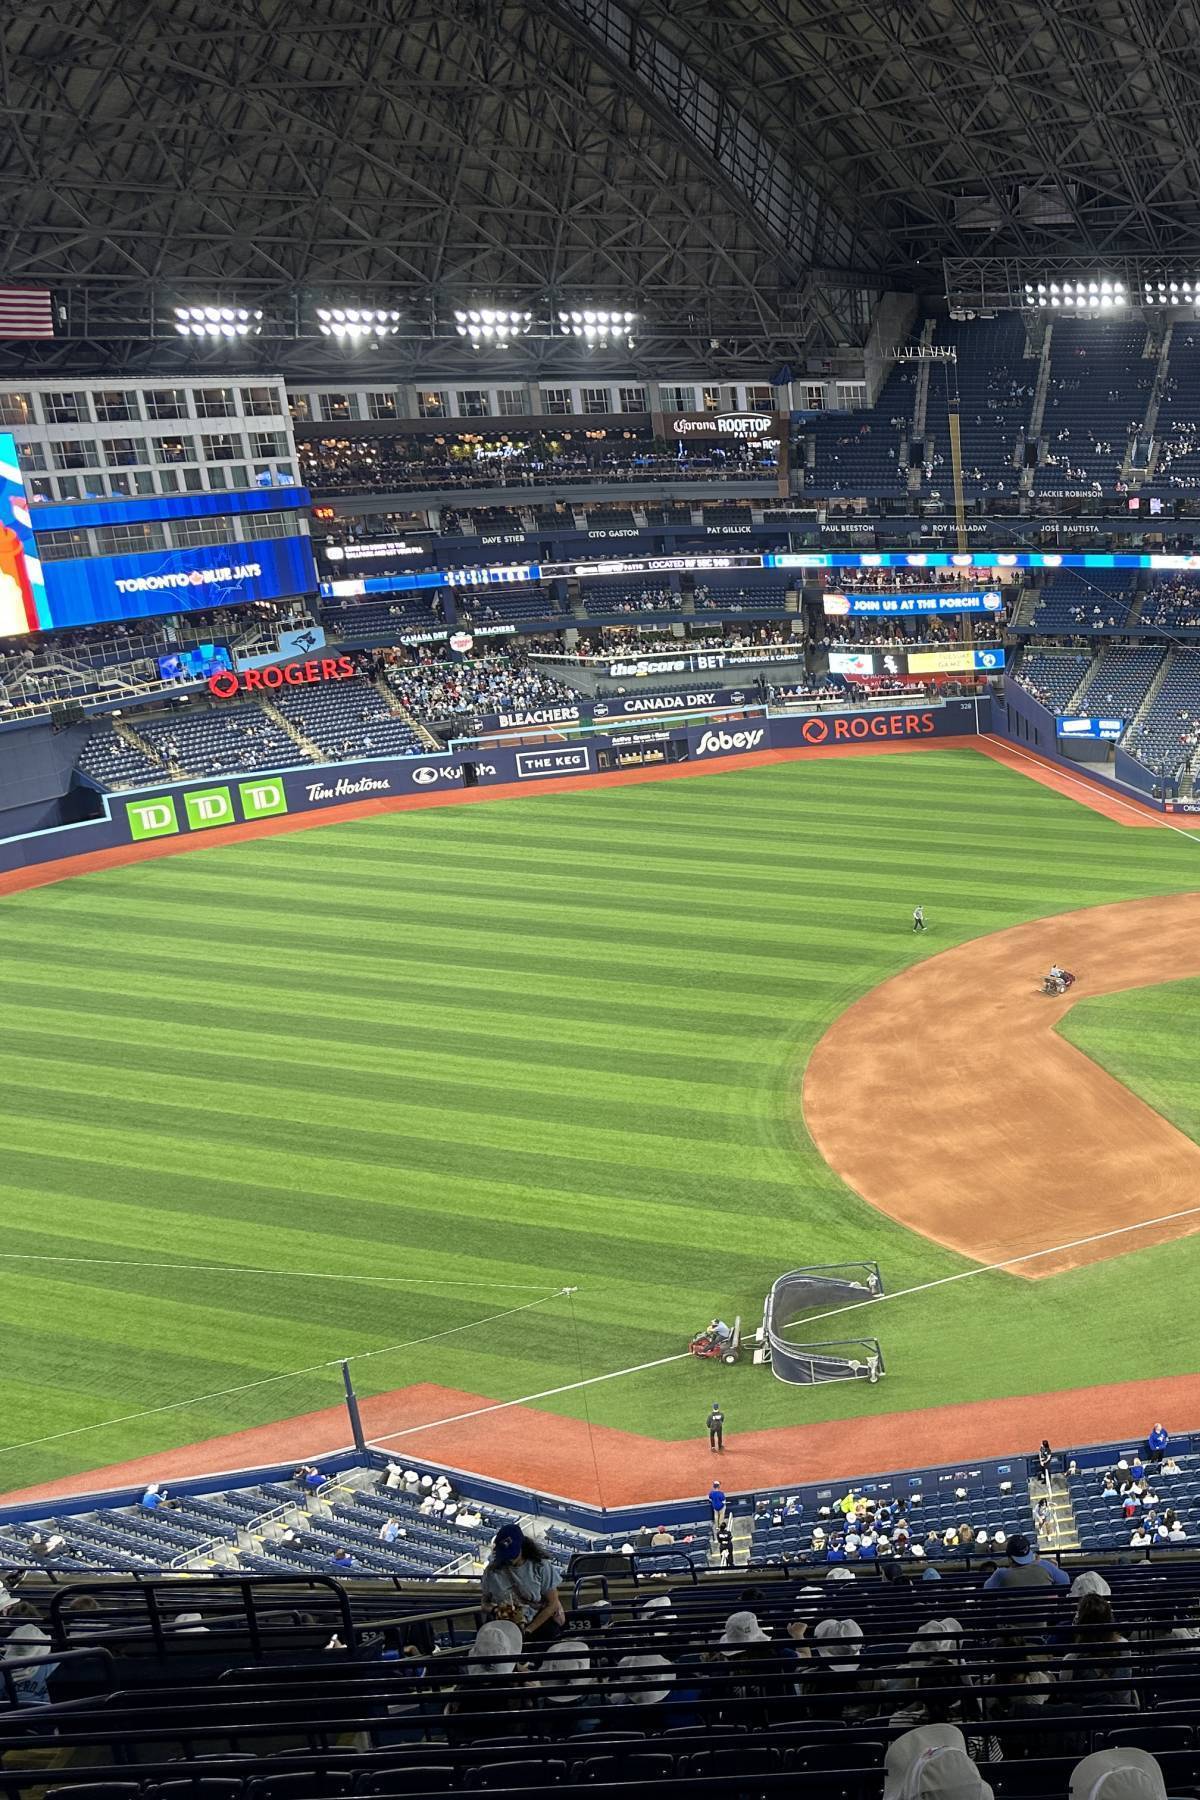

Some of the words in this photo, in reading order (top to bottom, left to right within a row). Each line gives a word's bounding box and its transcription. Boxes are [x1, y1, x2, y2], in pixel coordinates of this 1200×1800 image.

[673, 418, 716, 434] Corona
[717, 418, 772, 432] ROOFTOP
[1038, 490, 1064, 498] JACKIE
[1065, 490, 1103, 498] ROBINSON
[588, 529, 606, 539] CITO
[608, 529, 639, 538] GASTON
[706, 526, 721, 534] PAT
[722, 525, 751, 534] GILLICK
[841, 524, 875, 532] BEESTON
[932, 524, 949, 532] ROY
[949, 524, 987, 532] HALLADAY
[1040, 523, 1060, 532] JOSÉ
[1063, 525, 1100, 533] BAUTISTA
[481, 535, 502, 544] DAVE
[504, 534, 525, 543] STIEB
[648, 559, 685, 568] LOCATED
[115, 573, 190, 593] TORONTO
[202, 567, 233, 584] BLUE
[233, 563, 262, 580] JAYS
[853, 600, 880, 611] JOIN
[882, 600, 898, 611] US
[900, 600, 914, 610] AT
[916, 599, 937, 609] THE
[939, 597, 980, 608] PORCH!
[400, 632, 433, 644] CANADA
[433, 631, 448, 641] DRY
[473, 624, 516, 636] BLEACHERS
[609, 658, 686, 677] theScore
[697, 654, 727, 670] BET
[729, 655, 770, 665] SPORTSBOOK
[775, 653, 800, 662] CASINO
[244, 655, 355, 692] ROGERS
[623, 695, 684, 712] CANADA
[959, 702, 972, 710] 328
[499, 706, 579, 728] BLEACHERS
[834, 712, 936, 740] ROGERS
[695, 726, 764, 755] Sobeys
[526, 759, 552, 770] THE
[555, 755, 582, 766] KEG
[440, 762, 497, 780] Kuota
[305, 782, 334, 801] Tim
[334, 776, 391, 797] Hortons
[245, 785, 281, 810] TD
[189, 794, 228, 820] TD
[132, 804, 172, 831] TD
[568, 1619, 592, 1631] 533
